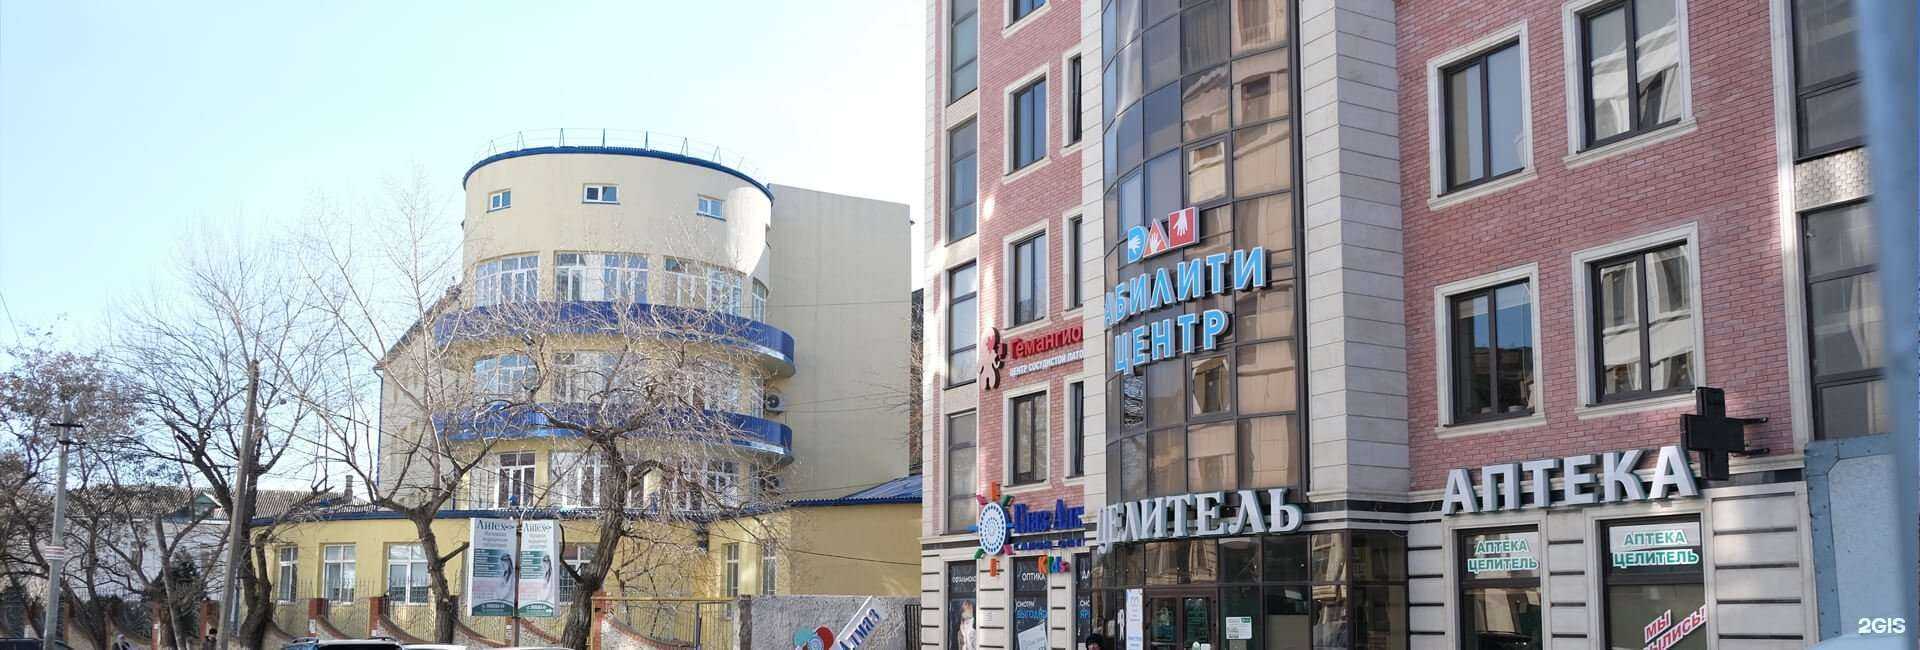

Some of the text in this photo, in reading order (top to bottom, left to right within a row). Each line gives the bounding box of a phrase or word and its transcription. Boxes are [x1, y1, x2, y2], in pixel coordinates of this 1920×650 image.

[1104, 246, 1267, 327] АБИЛИТИ
[1114, 309, 1229, 375] ЦЕНТР
[1010, 366, 1026, 378] ЦЕНТР
[1442, 445, 1699, 515] АПТЕКА
[1475, 539, 1529, 554] АПТЕКА
[1623, 530, 1687, 547] АПТЕКА
[1468, 557, 1538, 572] ЦЕЛИТЕЛЬ
[1614, 550, 1699, 567] ЦЕЛИТЕЛЬ
[1021, 572, 1047, 582] ОПТИКА
[1645, 611, 1671, 641] МЫ
